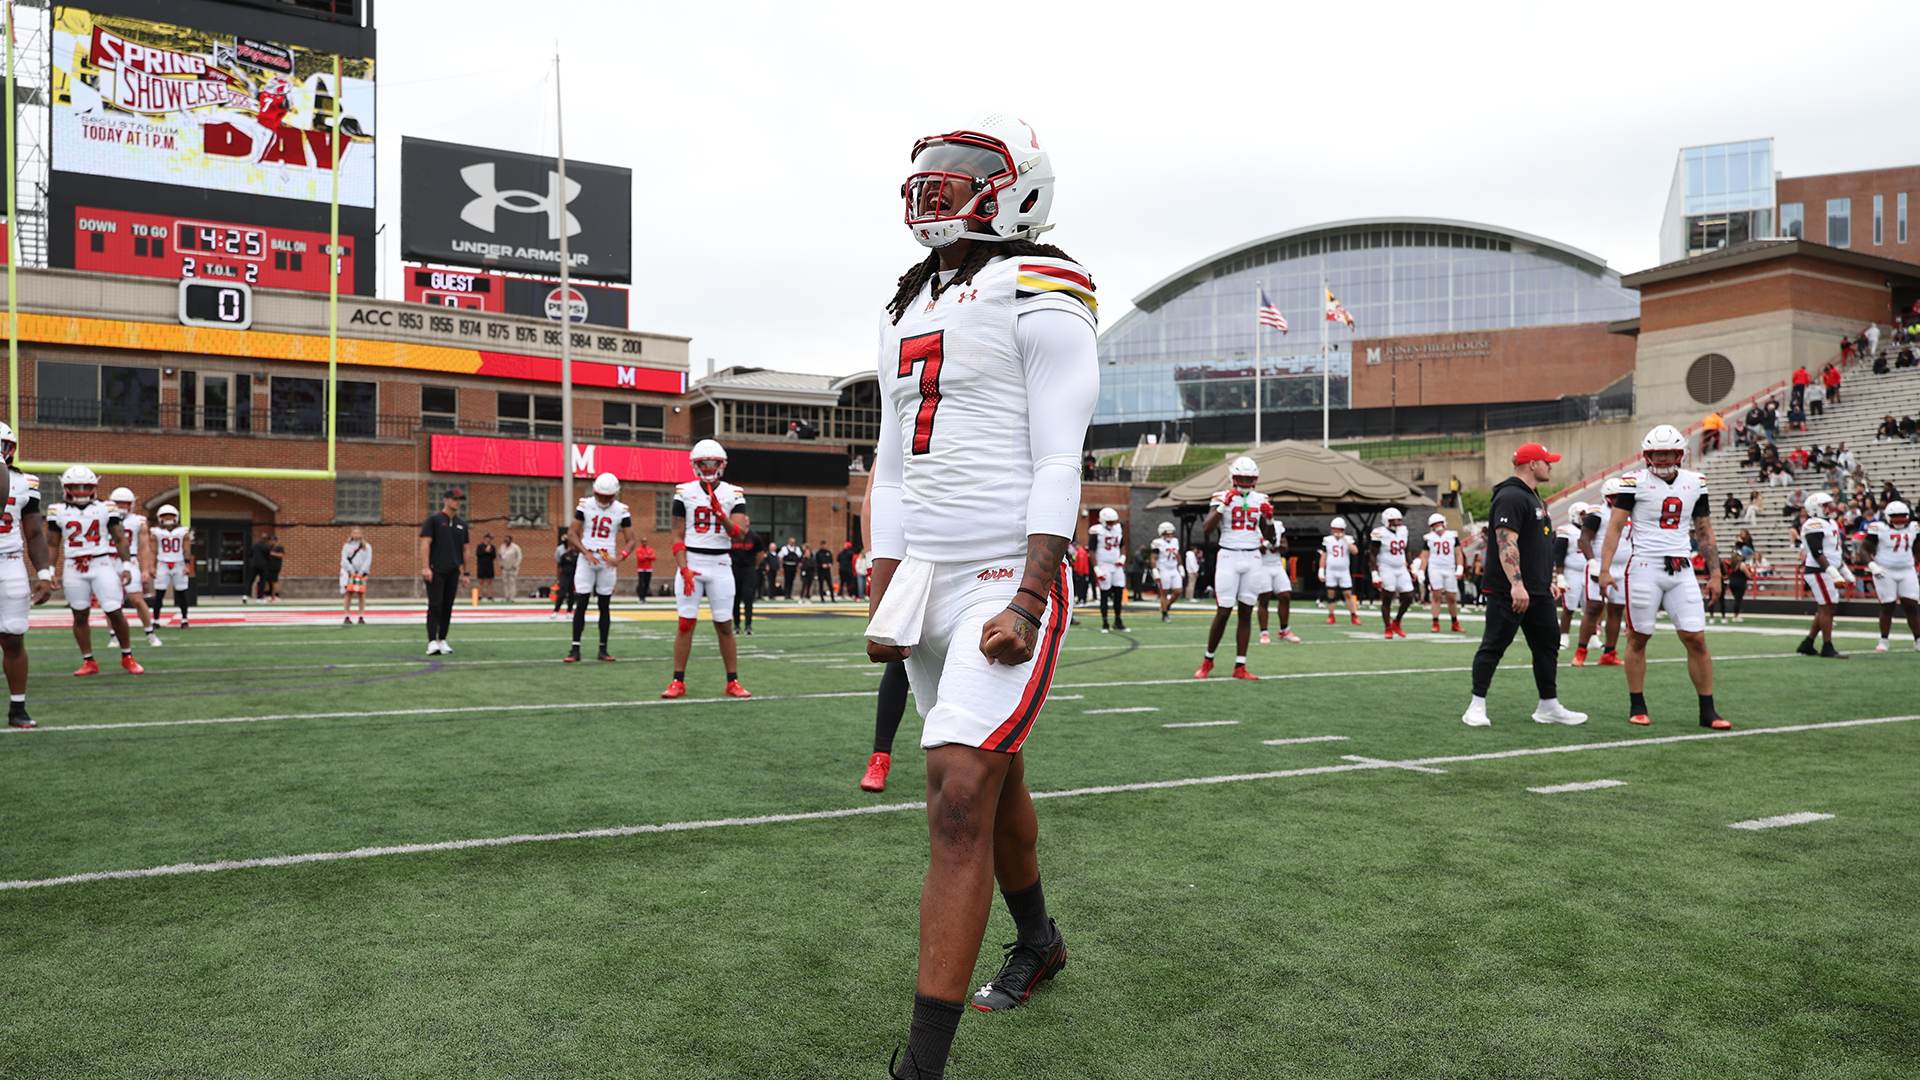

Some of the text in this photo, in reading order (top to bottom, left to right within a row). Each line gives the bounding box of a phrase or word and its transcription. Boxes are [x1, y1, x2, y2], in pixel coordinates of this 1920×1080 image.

[98, 30, 206, 74] SPRING
[123, 65, 227, 110] SHOWCASE
[83, 124, 179, 151] TODAY AT 1 P.M.
[119, 121, 178, 136] STADIUM
[204, 121, 352, 170] DAY
[79, 218, 117, 233] DOWN
[132, 223, 168, 238] TO GO
[200, 227, 261, 256] 4:25
[270, 238, 307, 253] BALL ON
[451, 239, 589, 266] UNDER ARMOUR
[182, 256, 195, 277] 2
[206, 263, 236, 277] T.O.L.
[244, 262, 259, 284] 2
[431, 272, 475, 292] GUEST
[218, 288, 240, 322] 0
[350, 308, 393, 326] ACC
[398, 311, 424, 331] 1953
[429, 315, 454, 333] 1955
[459, 319, 481, 336] 1974
[487, 322, 510, 341] 1975
[515, 326, 537, 343] 1976
[570, 332, 592, 349] 1984
[597, 335, 617, 352] 1985
[622, 338, 642, 355] 2001
[1385, 340, 1491, 355] JONES-HILL HOUSE
[617, 365, 636, 388] M
[897, 329, 945, 455] 7
[570, 443, 597, 475] M
[693, 506, 721, 534] 81
[1230, 506, 1258, 531] 85
[1659, 496, 1683, 530] 8
[65, 519, 101, 548] 24
[591, 514, 612, 539] 16
[161, 537, 180, 553] 80
[1104, 536, 1119, 551] 54
[1332, 544, 1345, 558] 51
[1433, 541, 1450, 556] 78
[1890, 533, 1910, 552] 71
[1165, 547, 1177, 561] 75
[976, 567, 1015, 584] Terps
